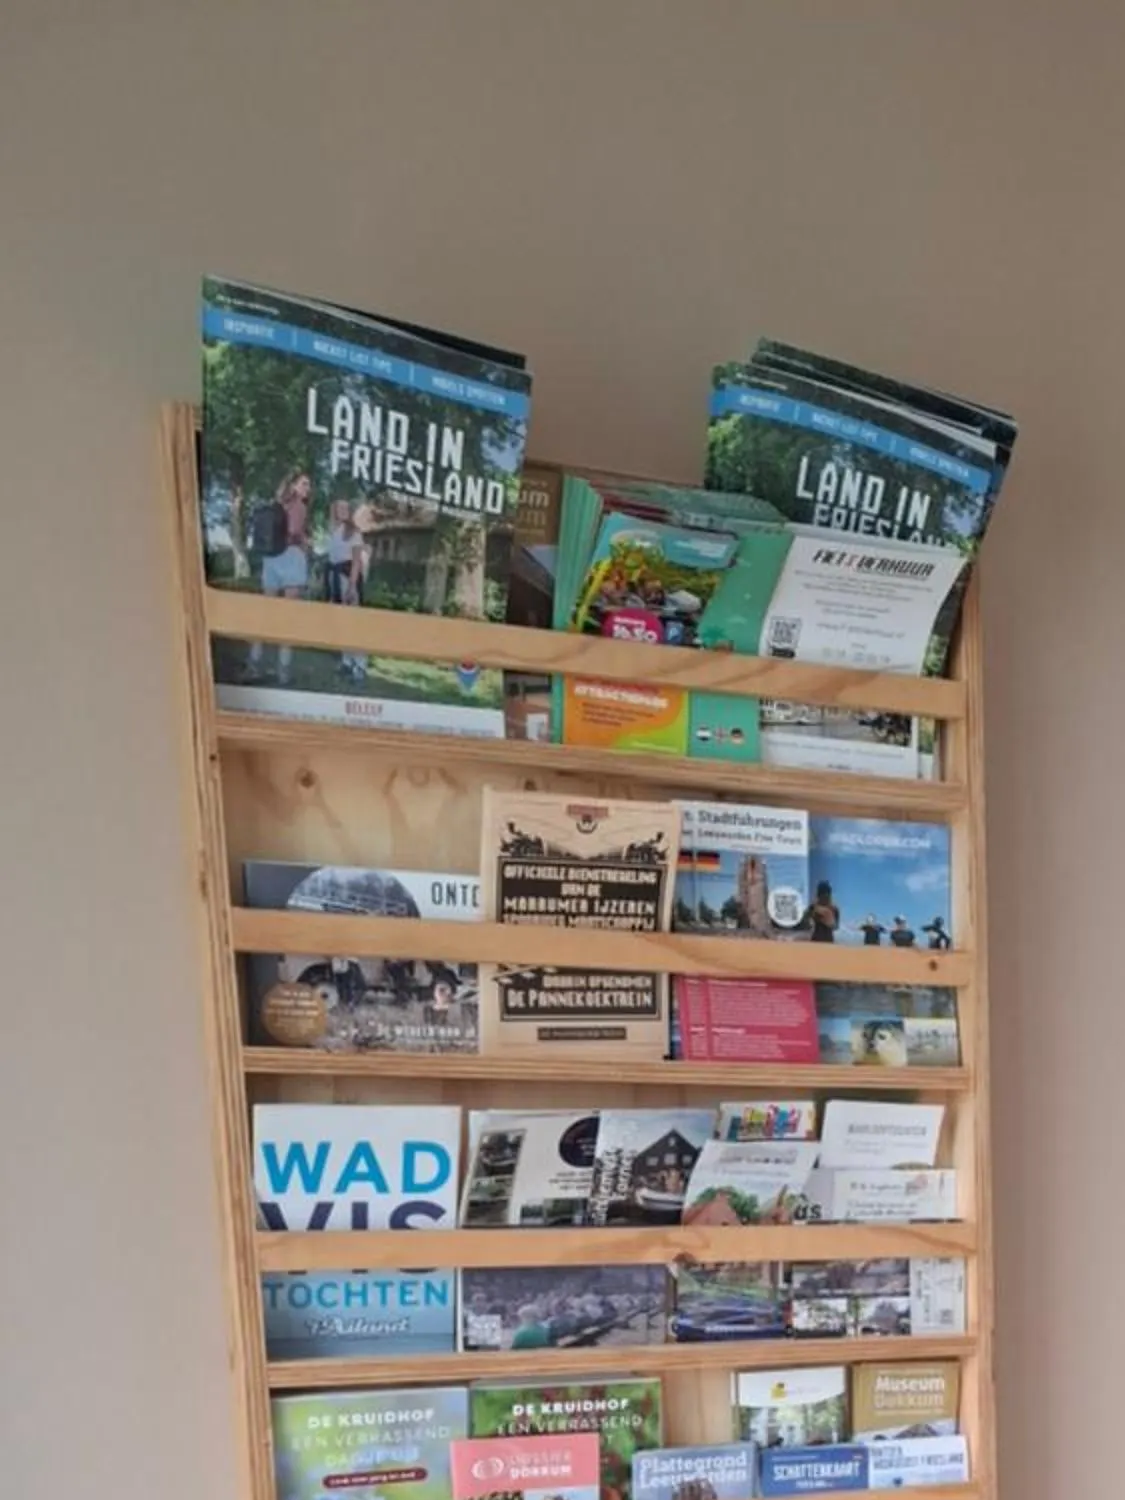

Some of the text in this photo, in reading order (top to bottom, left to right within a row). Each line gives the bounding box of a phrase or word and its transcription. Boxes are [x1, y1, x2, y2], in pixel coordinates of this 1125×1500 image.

[307, 386, 410, 456] LAND
[427, 422, 465, 471] IN
[331, 438, 503, 514] FRIESLAND
[796, 455, 885, 515] LAND
[895, 485, 931, 530] IN
[260, 1140, 451, 1194] WAD
[263, 1279, 449, 1310] TOCHTEN
[875, 1376, 945, 1393] Museum
[308, 1408, 435, 1429] DE KRUIDHOF
[512, 1398, 630, 1416] DE KRUIDHOF
[535, 1413, 643, 1433] VERRASSEND
[640, 1449, 747, 1473] Plattegrond
